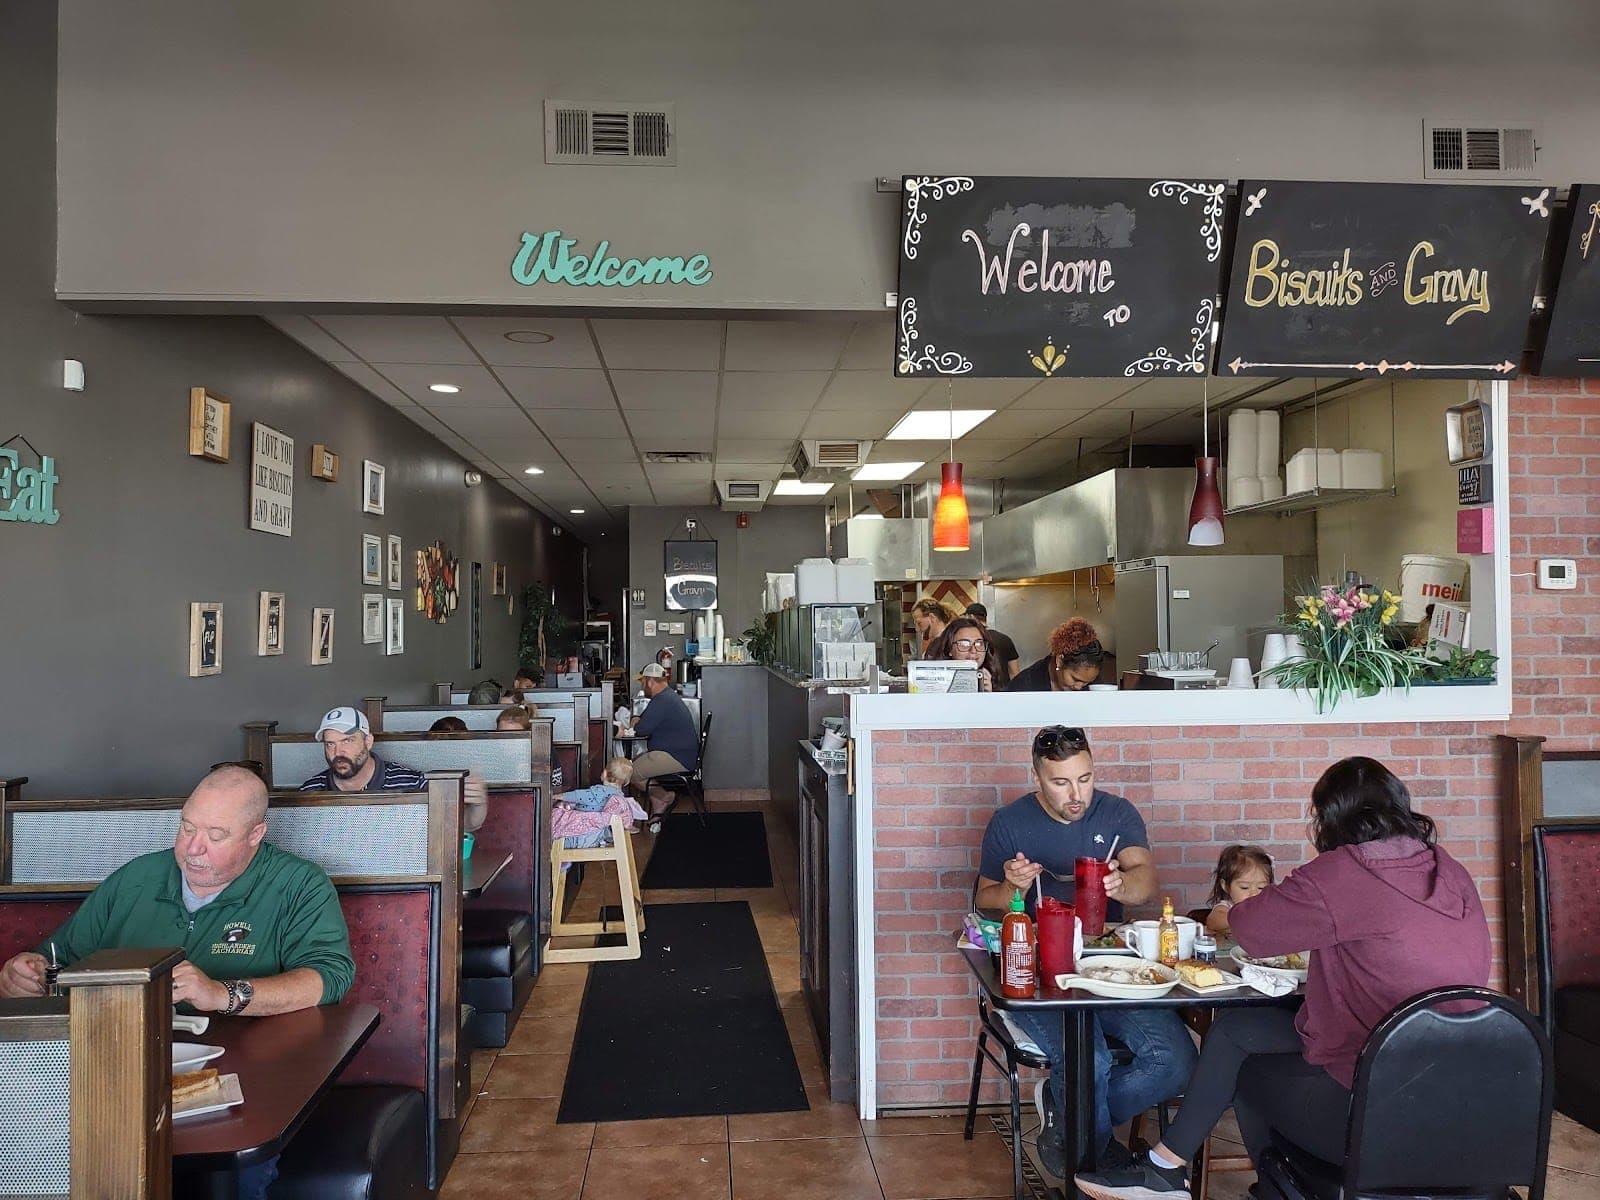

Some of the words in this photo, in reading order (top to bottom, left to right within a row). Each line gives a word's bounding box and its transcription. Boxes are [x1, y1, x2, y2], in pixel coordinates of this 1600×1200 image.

[511, 230, 714, 287] Welcome
[961, 222, 1115, 295] Welcome
[1245, 239, 1363, 307] Biscuits
[1403, 240, 1490, 325] Gravy
[1103, 304, 1131, 328] TO
[255, 429, 260, 453] I
[261, 431, 279, 461] LOVE
[280, 440, 294, 466] YOU
[255, 463, 269, 489] LIKE
[269, 468, 292, 497] BISCUITS
[254, 498, 269, 523] AND
[270, 502, 292, 529] GRAVY
